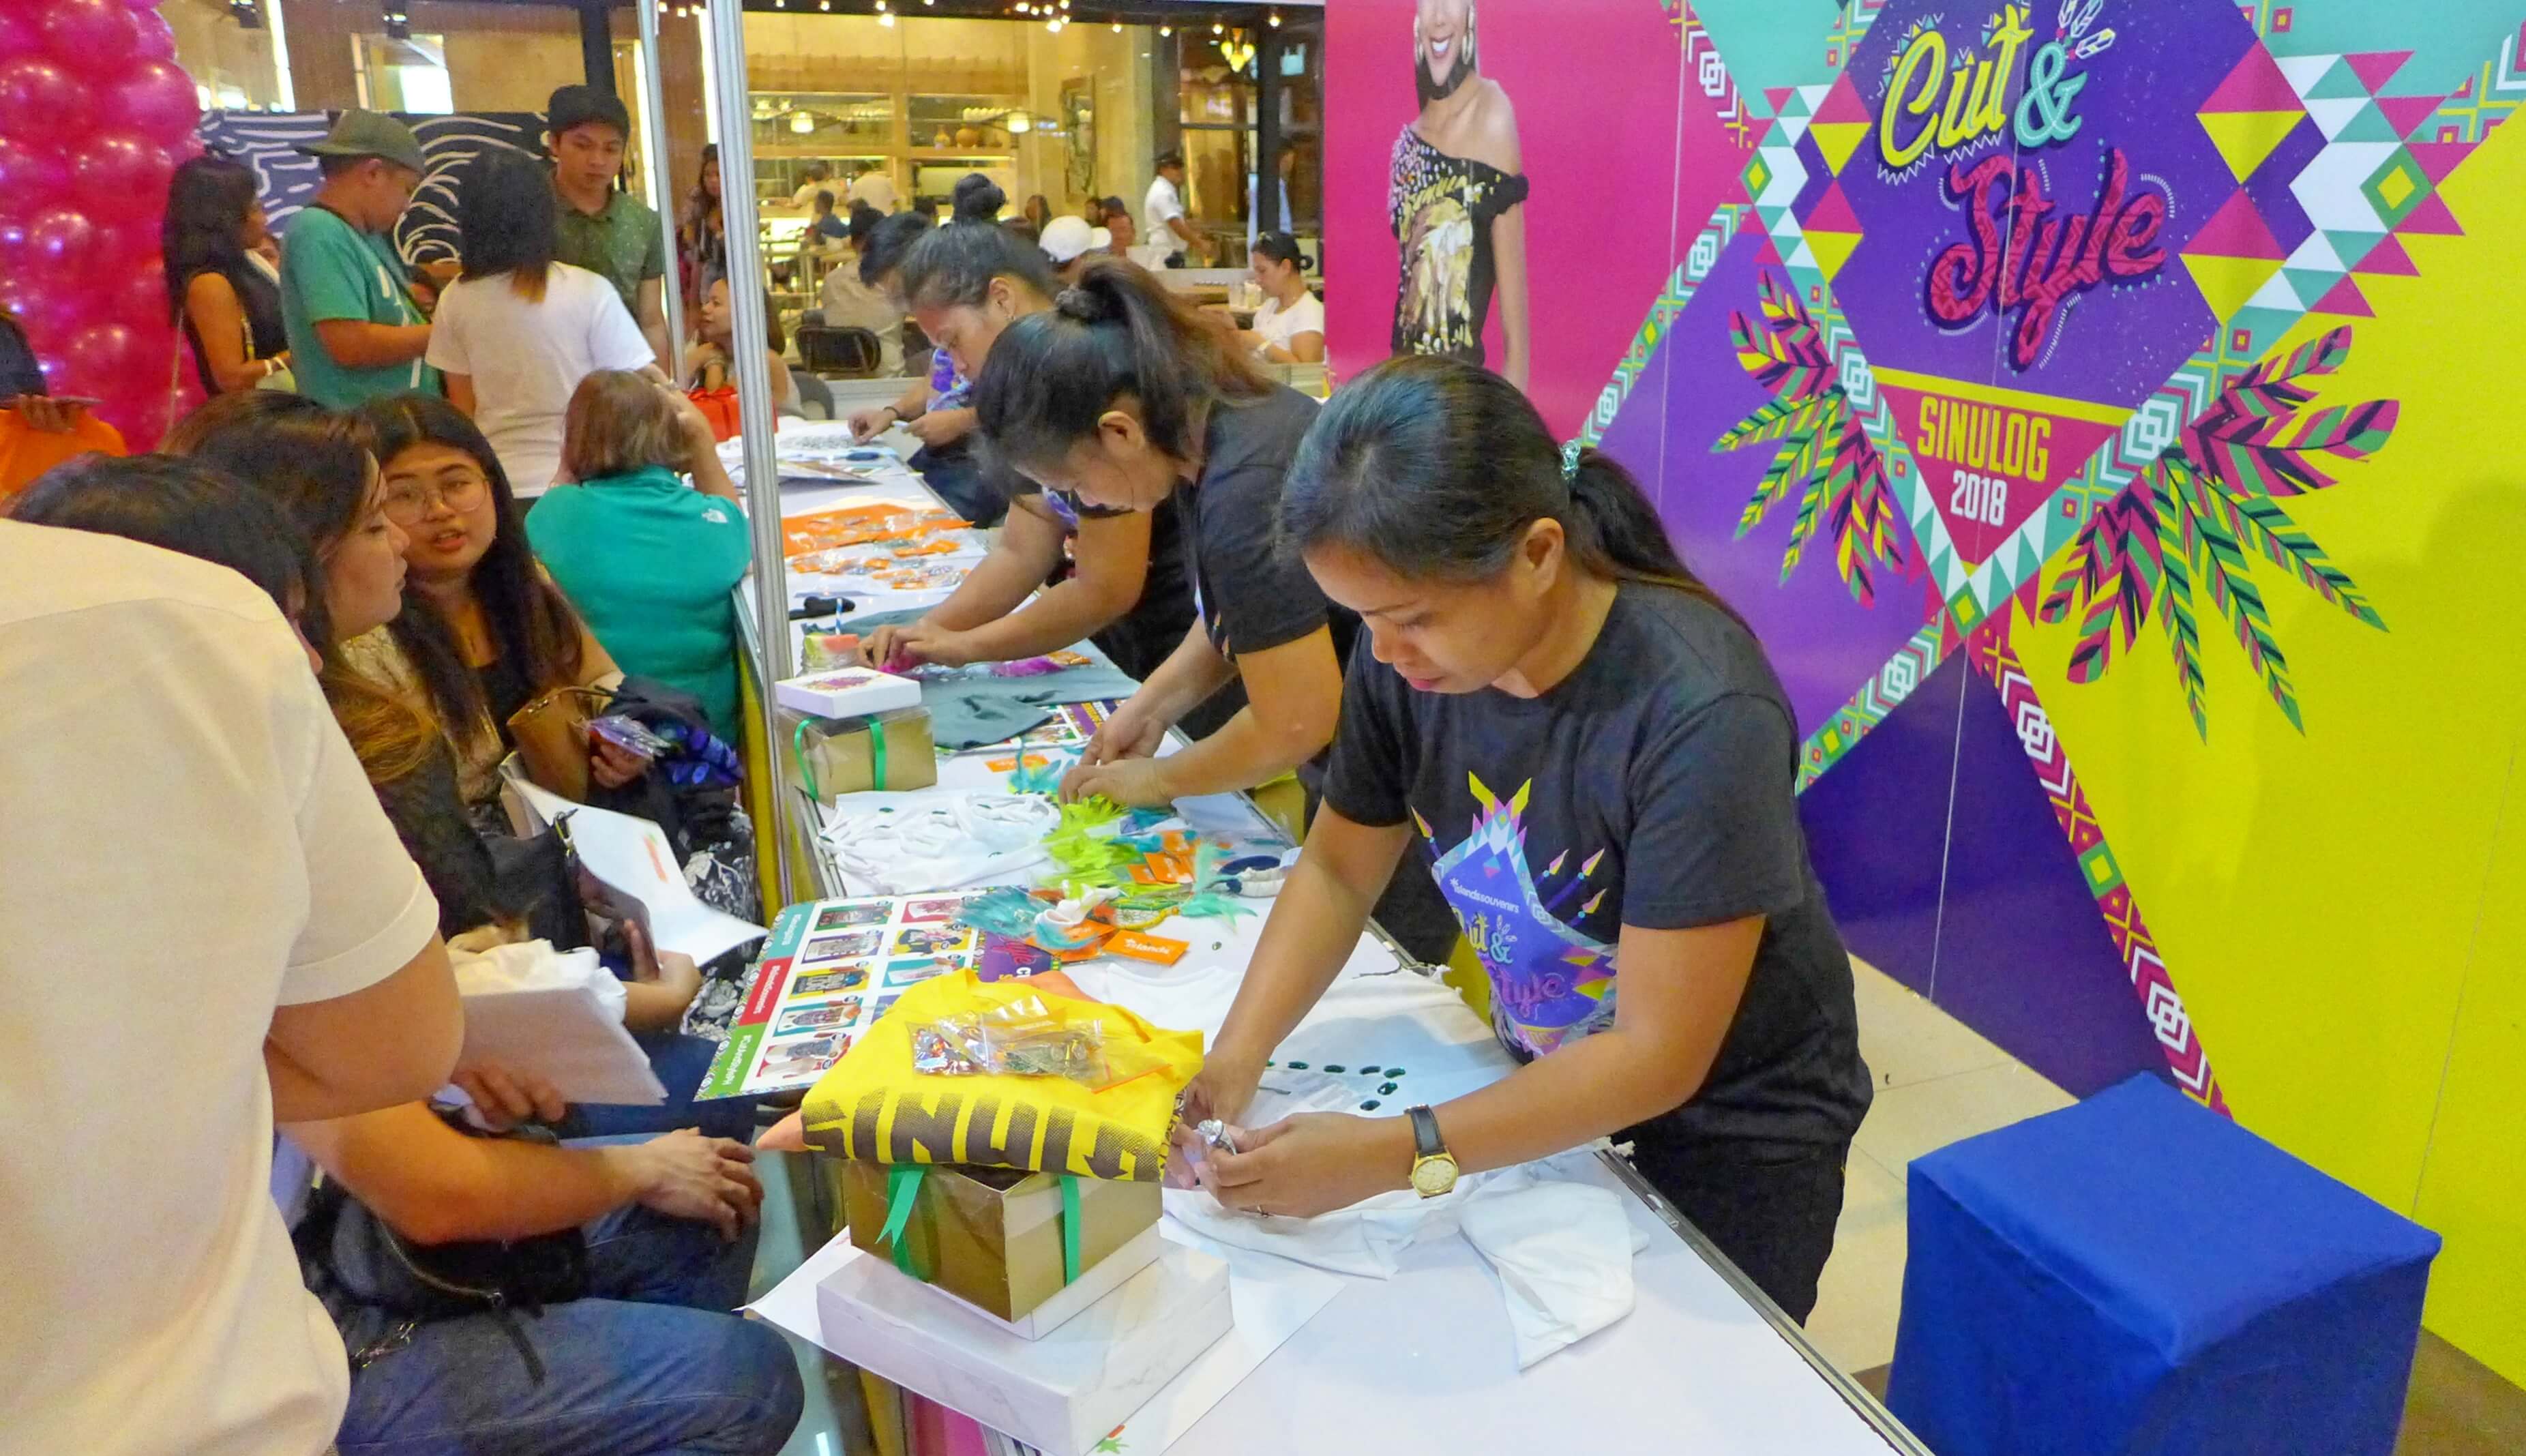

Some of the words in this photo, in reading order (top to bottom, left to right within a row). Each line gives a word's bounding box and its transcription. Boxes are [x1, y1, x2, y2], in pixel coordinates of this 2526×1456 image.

[1880, 3, 2034, 168] Cut
[2014, 41, 2088, 149] &
[1929, 147, 2167, 367] Style
[1916, 395, 2052, 484] SINULOG
[1950, 470, 2008, 528] 2018
